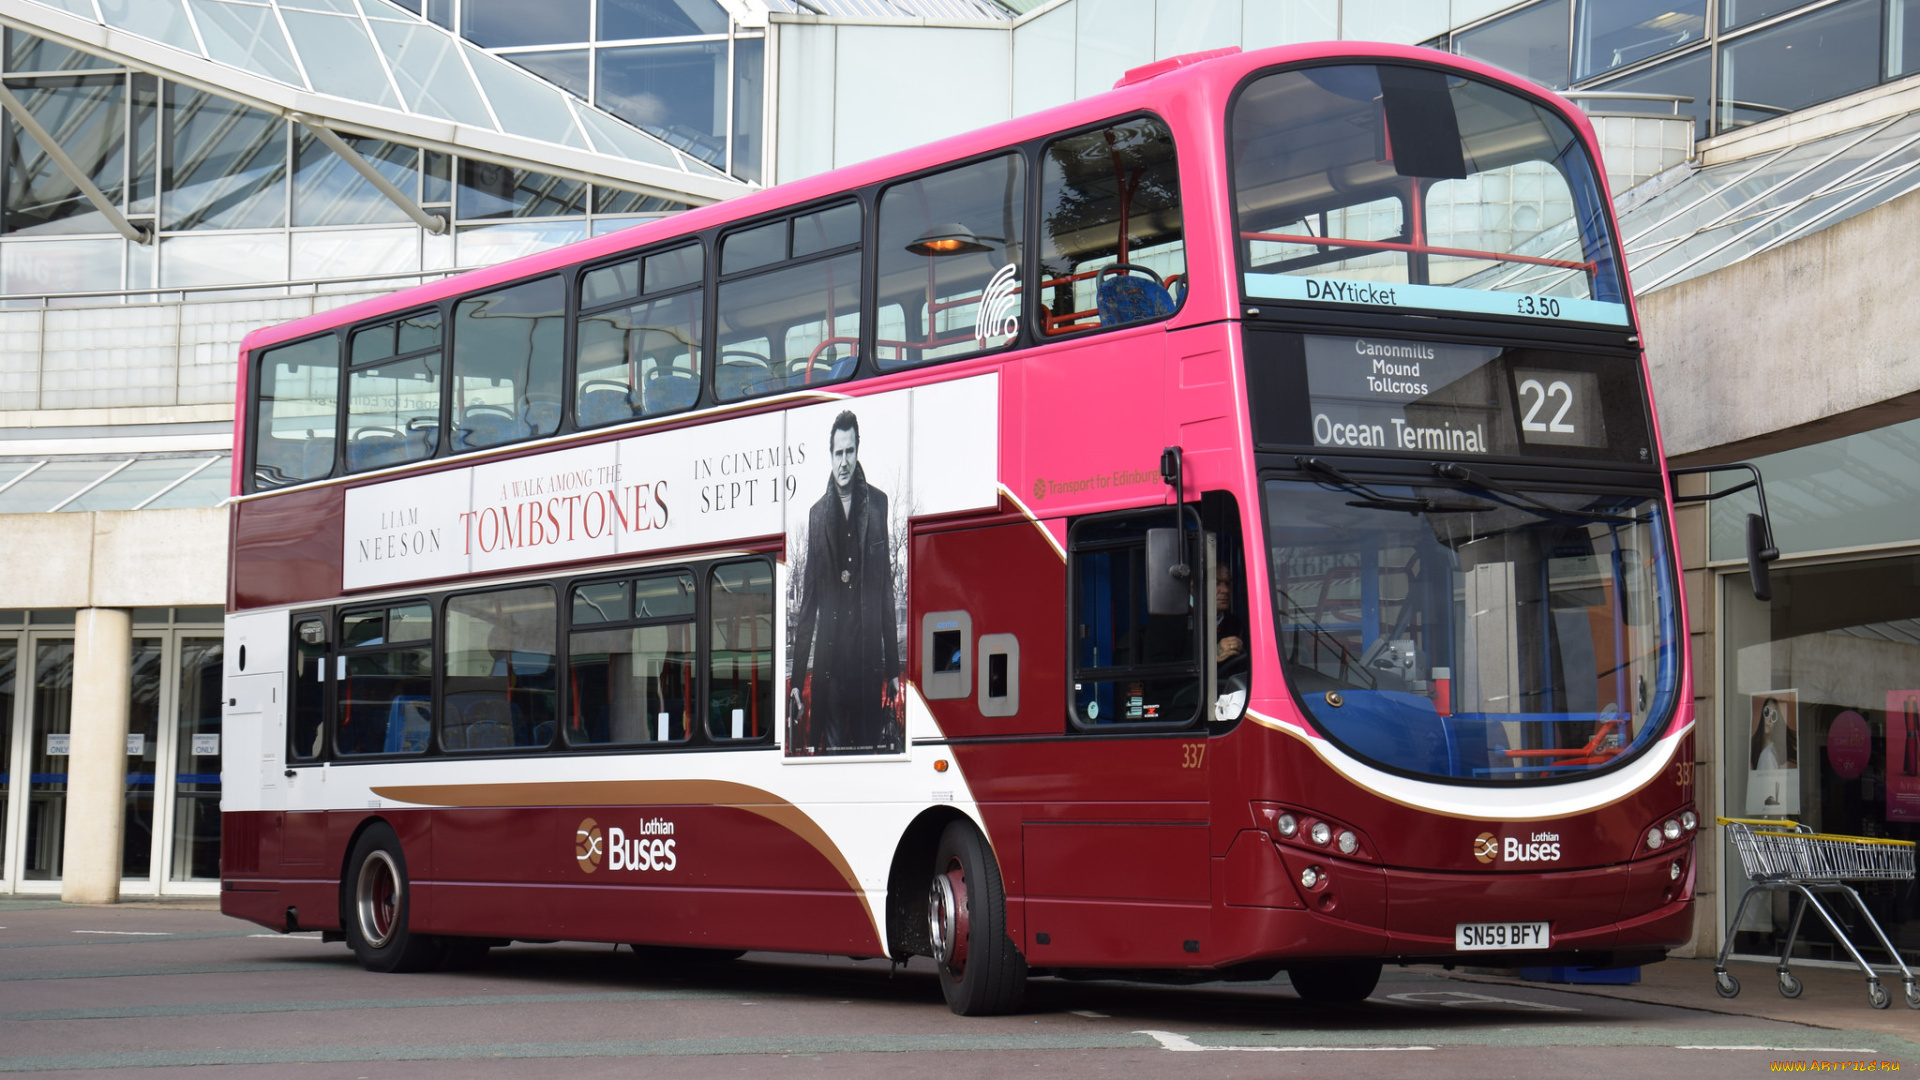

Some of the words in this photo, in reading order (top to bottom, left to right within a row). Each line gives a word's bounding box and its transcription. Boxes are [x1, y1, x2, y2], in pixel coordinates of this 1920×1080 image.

[1517, 296, 1560, 317] £3.50
[1355, 339, 1435, 360] Canonmills
[1373, 359, 1420, 377] Mound
[1367, 377, 1429, 395] Tollcross
[1519, 379, 1574, 434] 22
[1314, 413, 1385, 447] Ocean
[1391, 418, 1487, 453] Terminal
[694, 457, 712, 480] IN
[721, 442, 806, 476] CINEMAS
[500, 483, 507, 501] A
[511, 476, 544, 499] WALK
[547, 468, 593, 494] AMONG
[597, 463, 623, 485] THE
[700, 478, 758, 514] SEPT
[771, 474, 797, 503] 19
[1048, 477, 1095, 495] Transport
[1097, 474, 1111, 488] for
[381, 507, 418, 530] LIAM
[459, 480, 669, 556] TOMBSTONES
[358, 528, 441, 563] NEESON
[195, 746, 215, 754] ONLY
[1182, 744, 1206, 769] 337
[1675, 762, 1695, 786] 337
[640, 817, 674, 835] Lothian
[1531, 832, 1559, 842] Lothian
[608, 827, 677, 872] Buses
[1504, 837, 1561, 862] Buses
[1463, 926, 1506, 946] SN59
[1510, 924, 1542, 945] BFY
